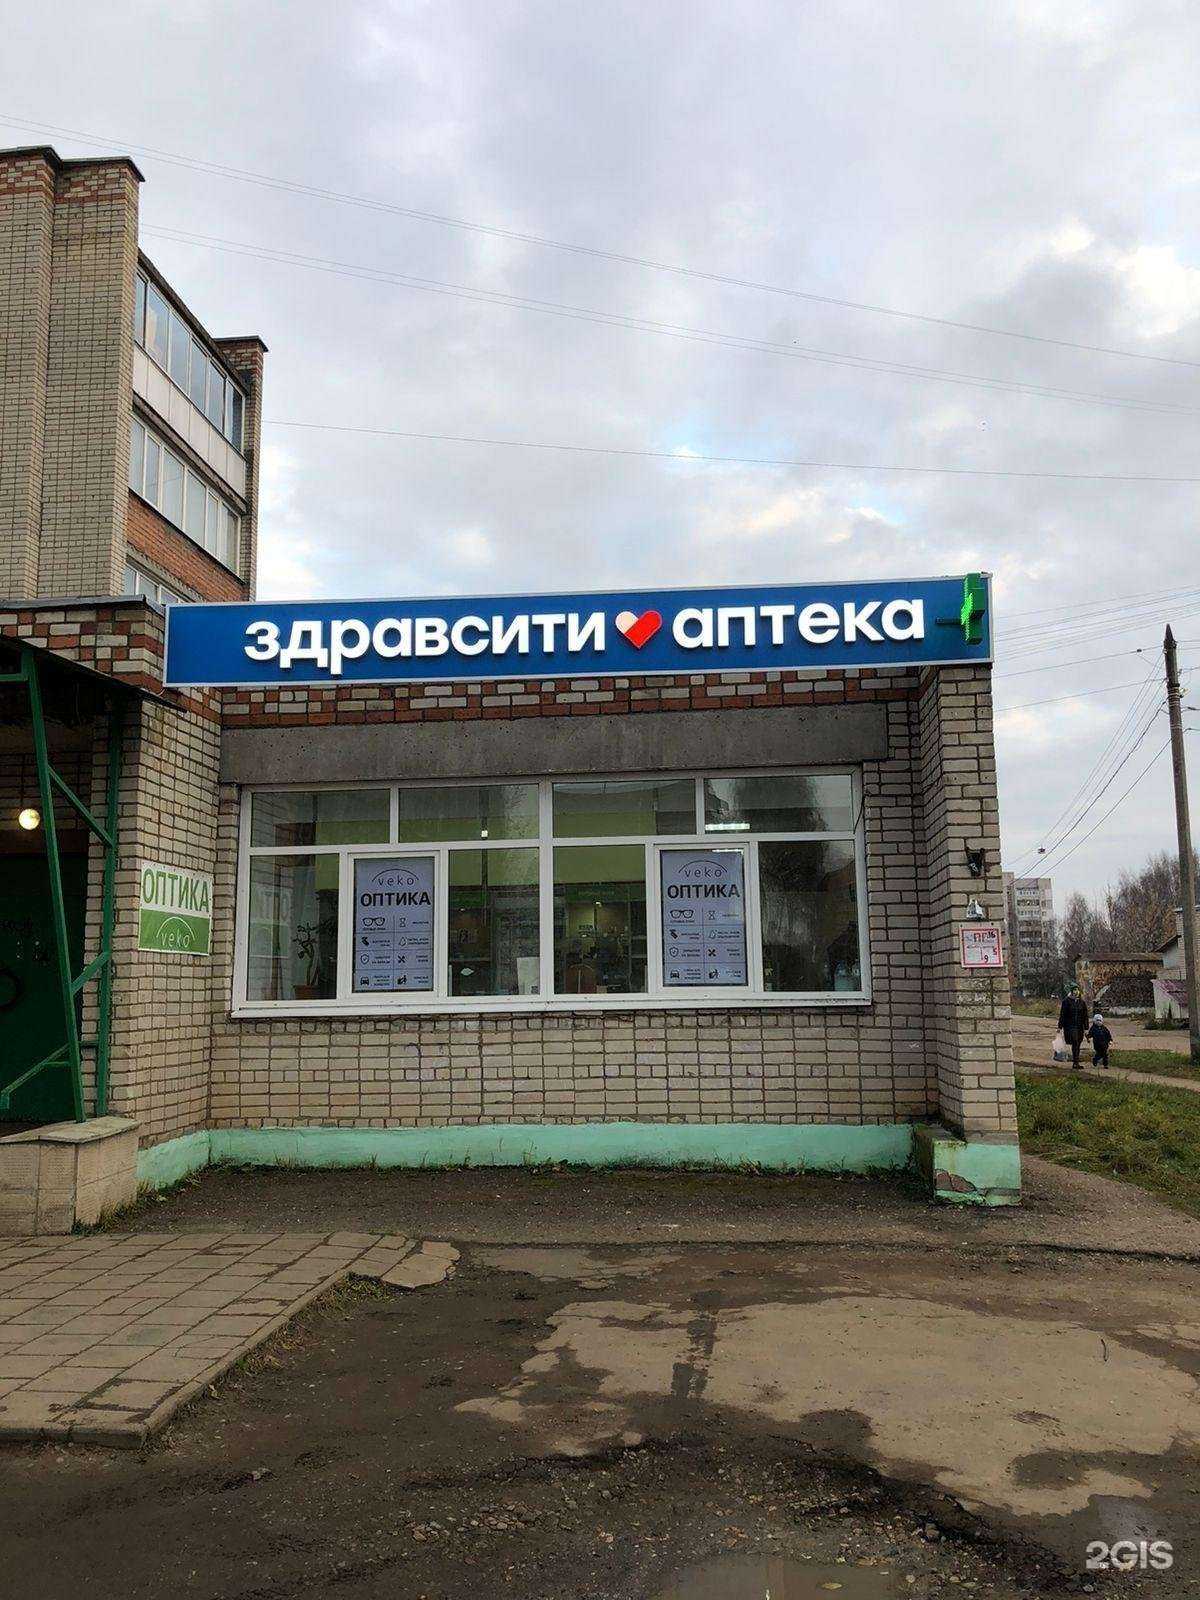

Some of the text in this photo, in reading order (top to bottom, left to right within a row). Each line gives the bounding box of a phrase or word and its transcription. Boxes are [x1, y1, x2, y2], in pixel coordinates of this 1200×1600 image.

[244, 598, 925, 675] здравсити аптека
[378, 873, 415, 886] veko
[684, 866, 722, 878] veko
[142, 867, 210, 913] ОПТИКА
[667, 883, 740, 899] ОПТИКА
[360, 891, 432, 907] ОПТИКА
[161, 927, 190, 948] veko
